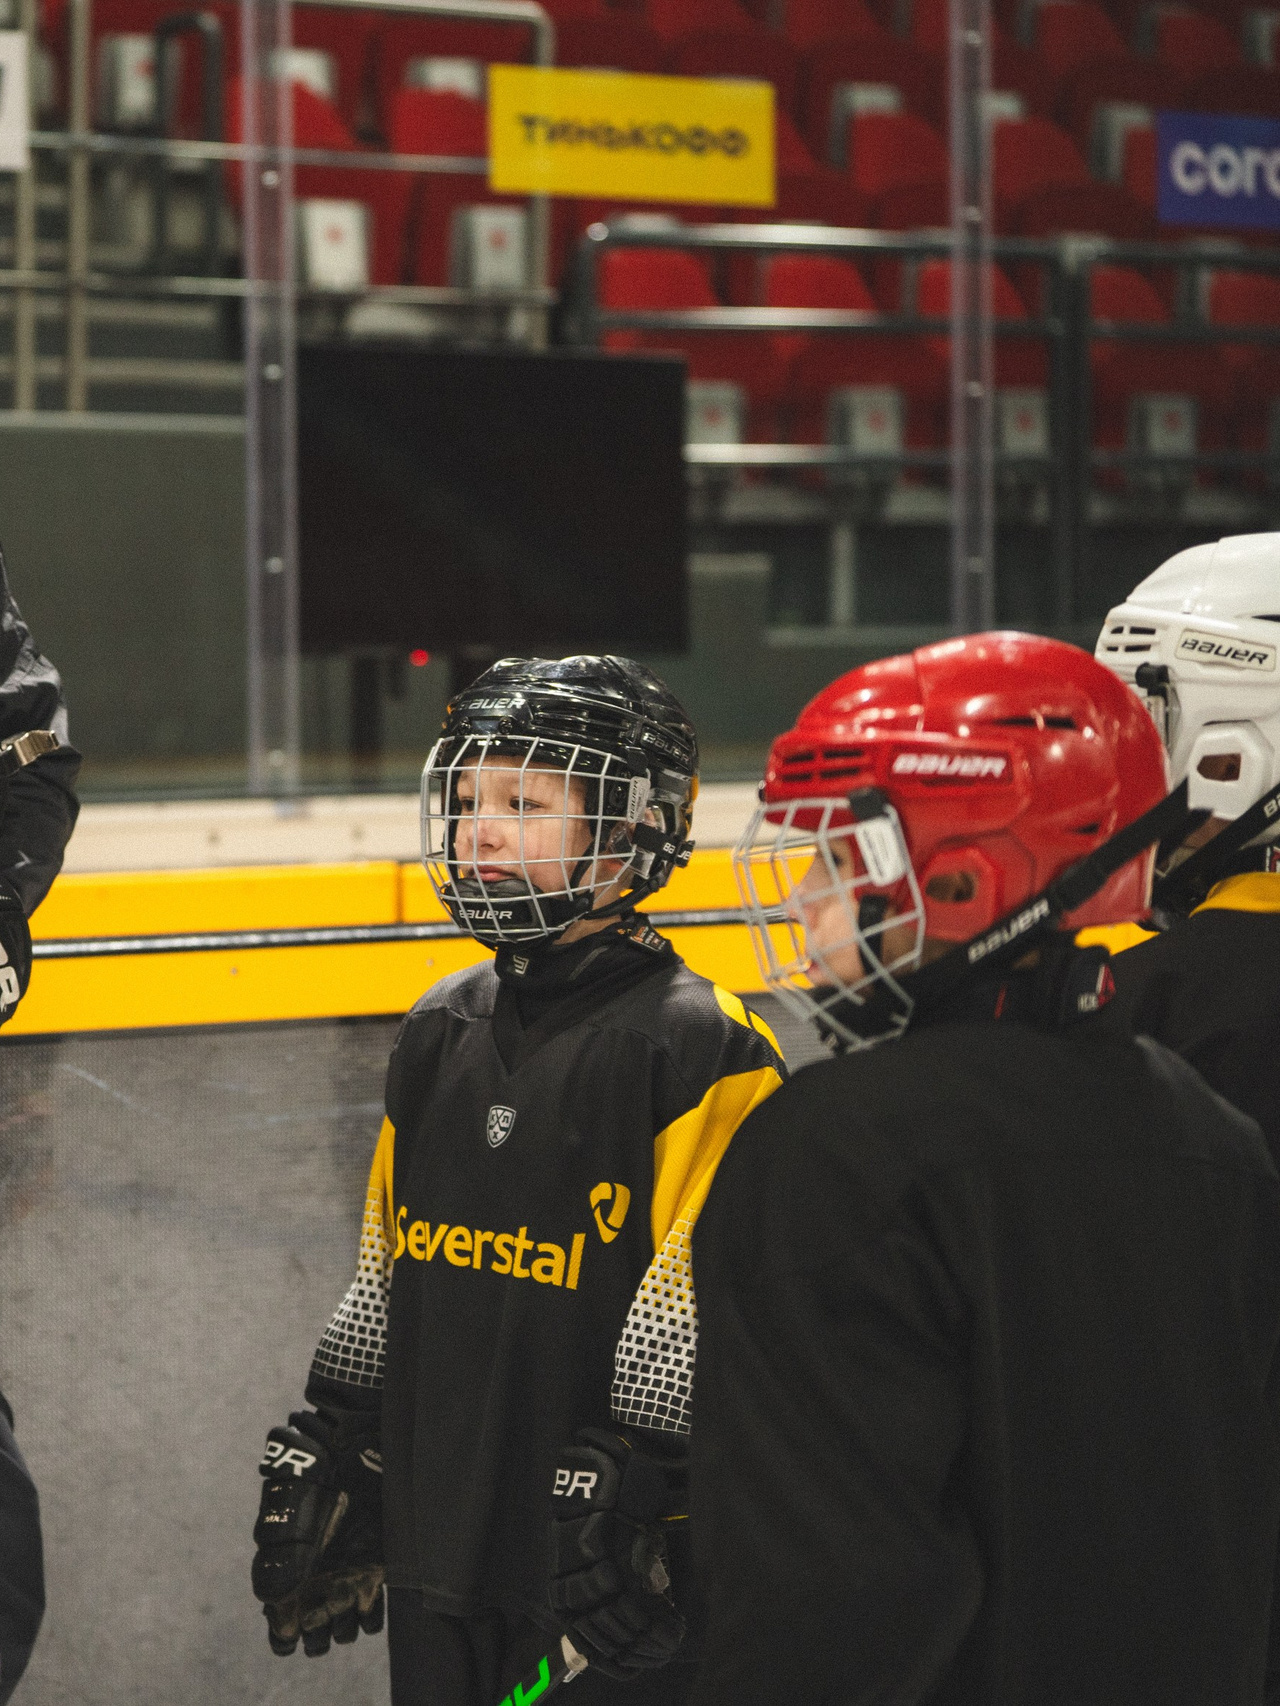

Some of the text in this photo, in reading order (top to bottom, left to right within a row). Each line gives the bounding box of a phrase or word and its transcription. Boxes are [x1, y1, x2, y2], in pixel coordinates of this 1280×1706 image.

[517, 112, 751, 159] ТИНЬКОФФ
[1181, 638, 1269, 665] BAUER
[642, 731, 691, 763] BAUER
[892, 753, 1007, 778] BAUER
[968, 898, 1050, 964] BAUER
[394, 1206, 587, 1291] Severstal
